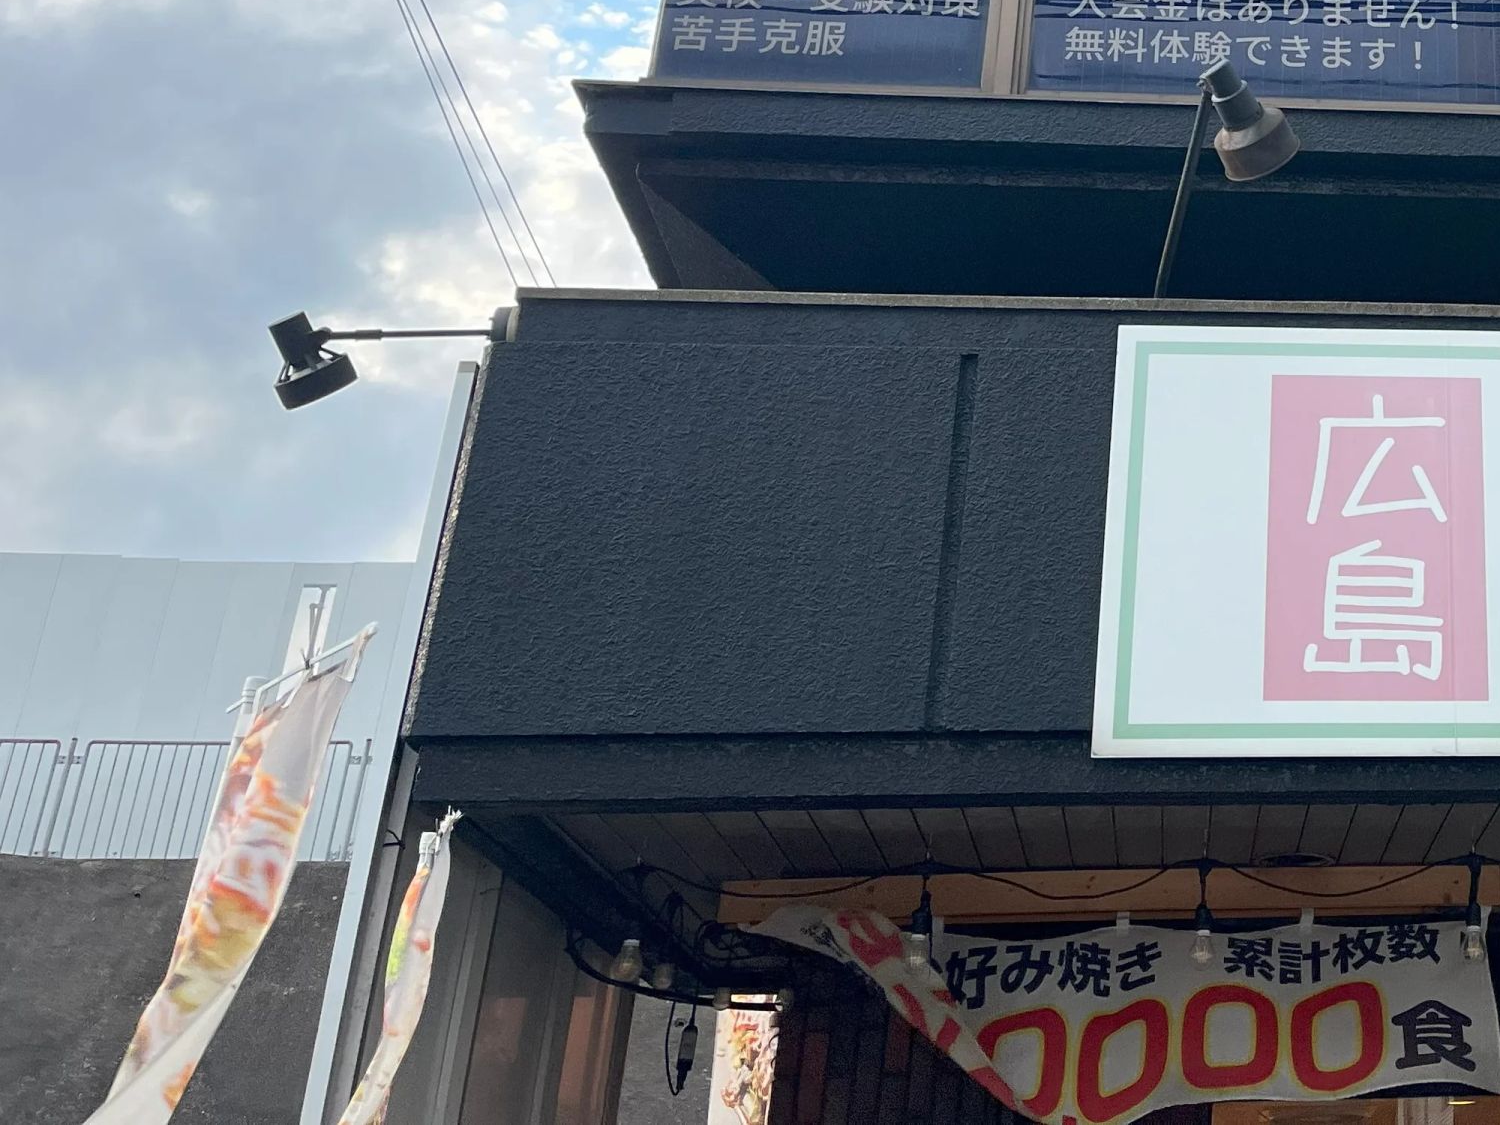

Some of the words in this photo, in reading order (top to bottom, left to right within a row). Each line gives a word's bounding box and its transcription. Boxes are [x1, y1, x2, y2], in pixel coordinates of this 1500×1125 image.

[671, 15, 847, 57] 苦手克服
[1063, 26, 1423, 70] 無料体験できます!
[1302, 393, 1447, 682] 広島
[931, 939, 1163, 1010] 好み焼き
[1223, 923, 1442, 985] 累計枚数
